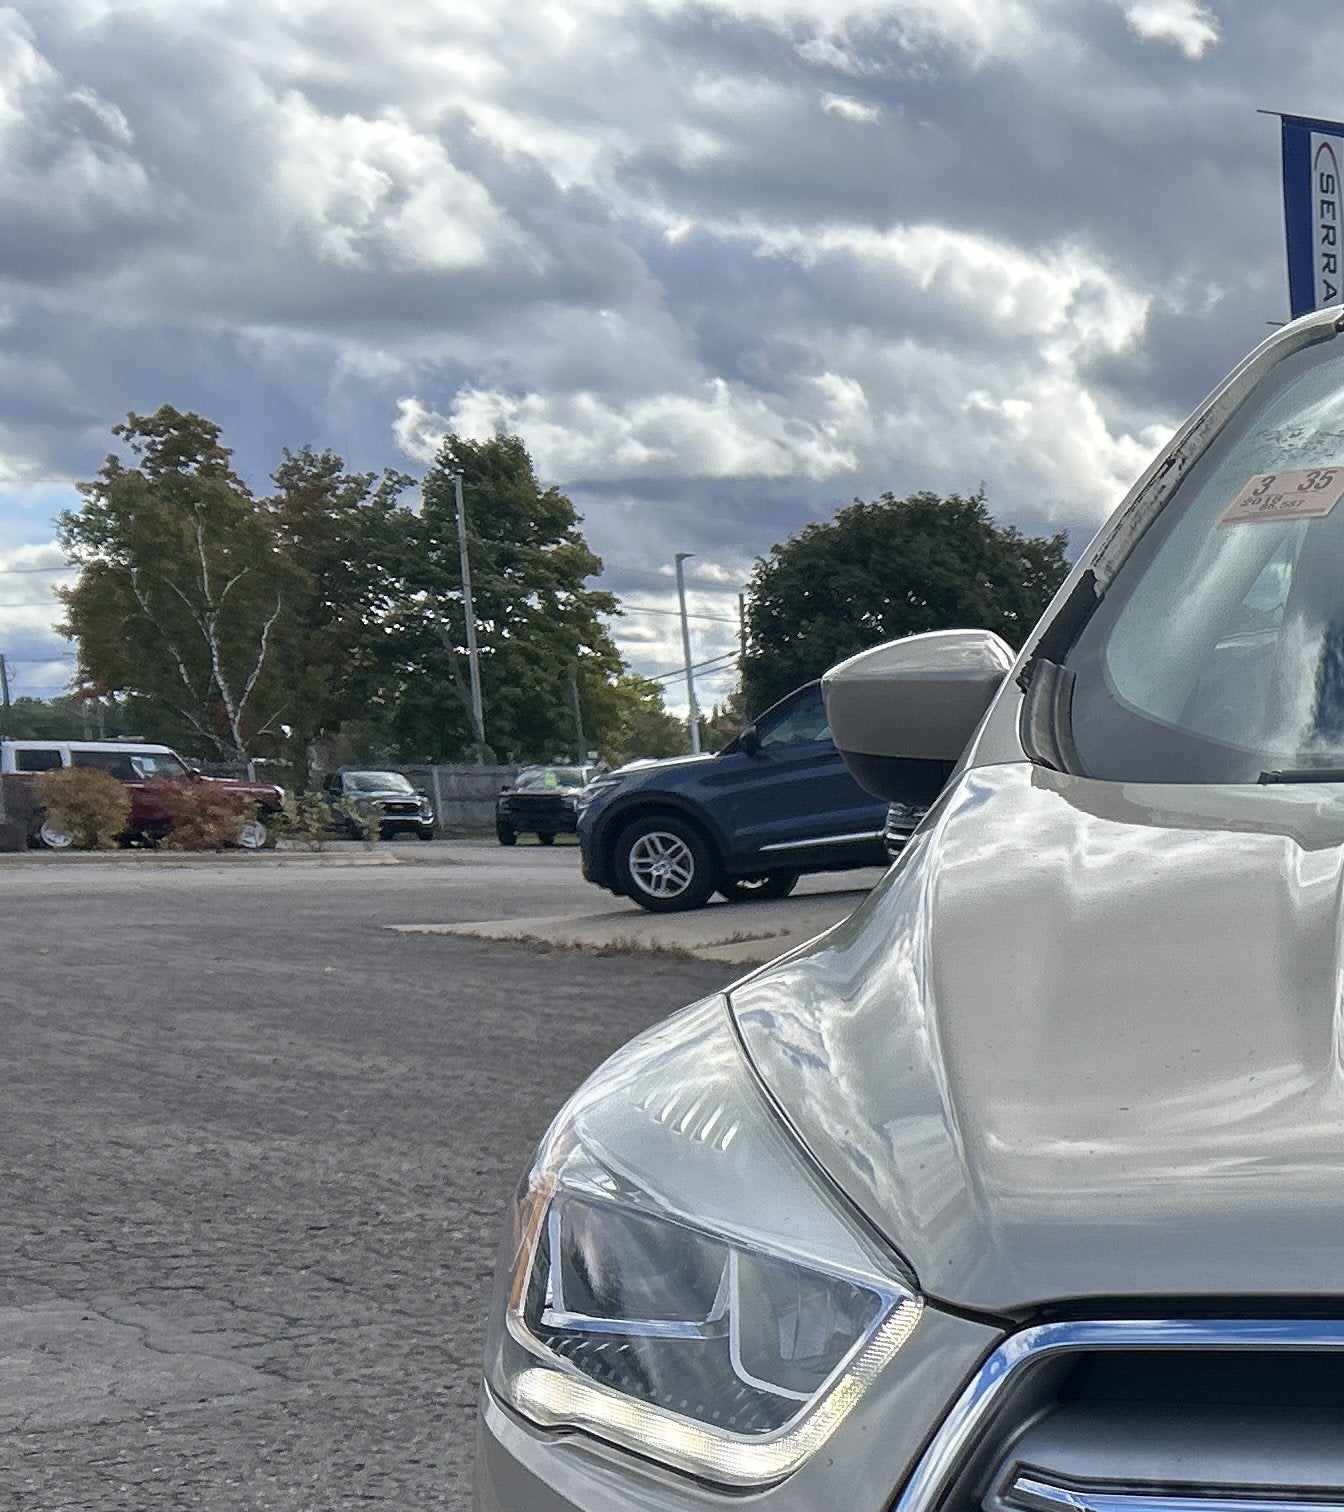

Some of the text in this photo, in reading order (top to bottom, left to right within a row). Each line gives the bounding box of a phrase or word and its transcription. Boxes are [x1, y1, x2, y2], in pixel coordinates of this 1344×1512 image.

[1319, 171, 1338, 303] SERRA
[1252, 469, 1339, 496] 3 35
